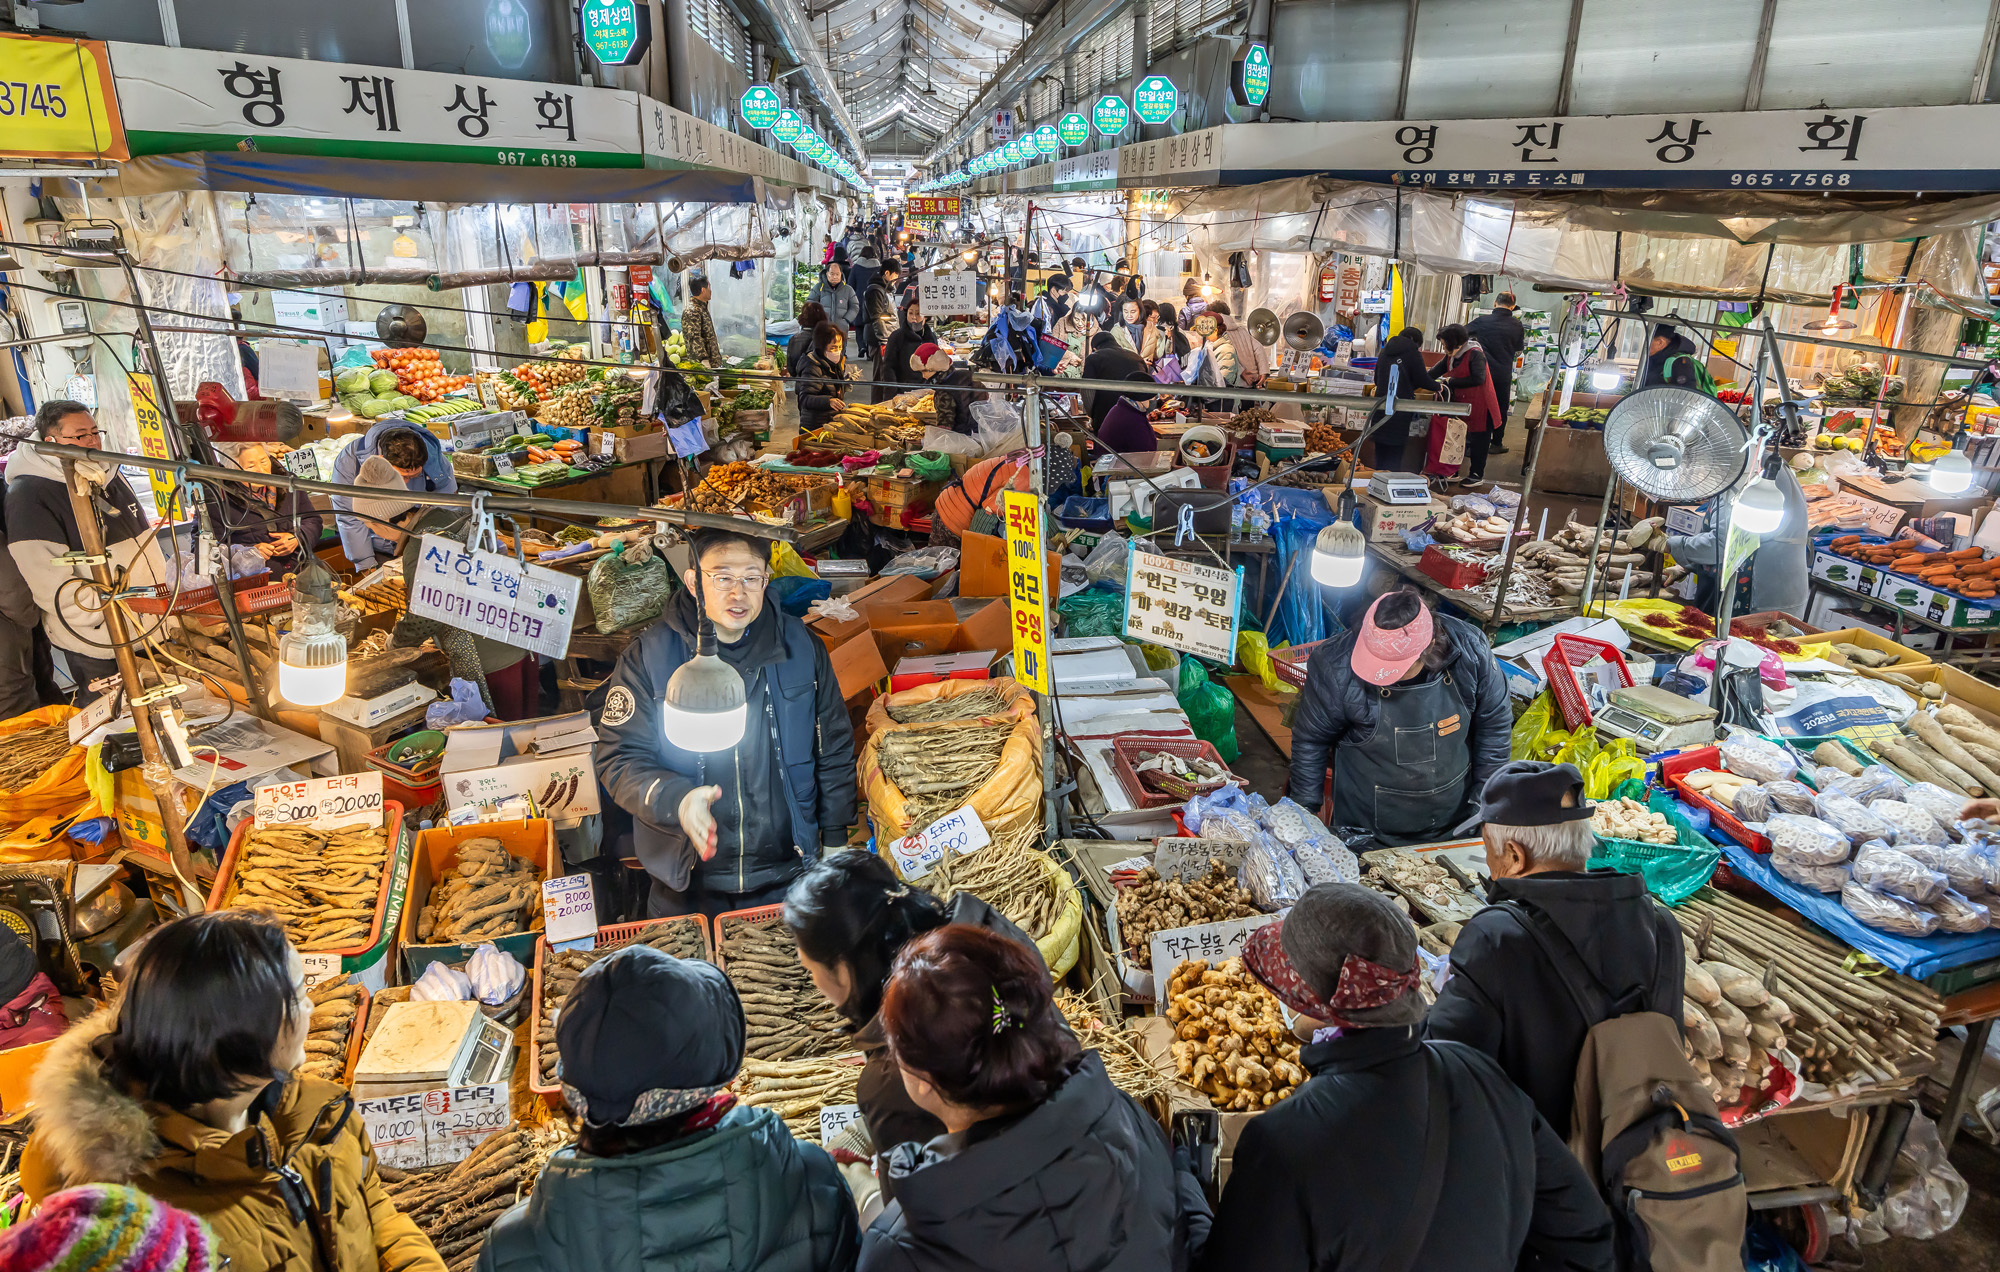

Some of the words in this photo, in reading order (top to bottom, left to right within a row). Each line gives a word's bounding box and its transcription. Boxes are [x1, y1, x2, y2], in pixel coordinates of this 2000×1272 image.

[588, 6, 631, 27] 형제상회
[596, 40, 628, 50] 967-6138
[1247, 63, 1267, 78] 영진상회
[0, 81, 66, 118] 3745
[218, 61, 577, 141] 형제상회
[745, 100, 777, 109] 대해상회
[1139, 91, 1173, 101] 한일상회
[1097, 108, 1126, 117] 정원식품
[1170, 132, 1213, 168] 한일상회
[1395, 114, 1868, 164] 영진상회
[1124, 145, 1155, 173] 정원식품
[1409, 173, 1436, 184] 오이
[1447, 173, 1474, 184] 호박
[1487, 173, 1515, 184] 고추
[924, 285, 938, 299] 연근
[942, 285, 955, 299] 우엉
[961, 285, 966, 298] 마
[137, 408, 159, 430] 우엉
[143, 437, 166, 458] 연근
[1008, 504, 1036, 537] 국산
[1013, 539, 1036, 560] 100%
[1144, 554, 1171, 569] 100%
[1173, 561, 1191, 574] 국산
[1193, 565, 1230, 582] 뿌리식품
[1013, 571, 1039, 605] 연근
[1146, 572, 1177, 593] 연근
[1193, 584, 1227, 607] 우엉
[1138, 595, 1152, 611] 마
[1163, 601, 1193, 621] 생강
[476, 602, 543, 638] 909673
[1015, 610, 1042, 644] 우엉
[1151, 626, 1184, 641] 돼지감자
[1024, 647, 1038, 680] 마
[1803, 713, 1836, 730] 2025년
[264, 783, 306, 803] 강원도
[327, 777, 358, 789] 더덕
[930, 815, 966, 839] 도라지
[558, 902, 592, 918] 20.000
[305, 958, 328, 969] 더덕
[359, 1095, 422, 1114] 제주도
[454, 1087, 494, 1103] 더덕
[822, 1112, 848, 1129] 영주
